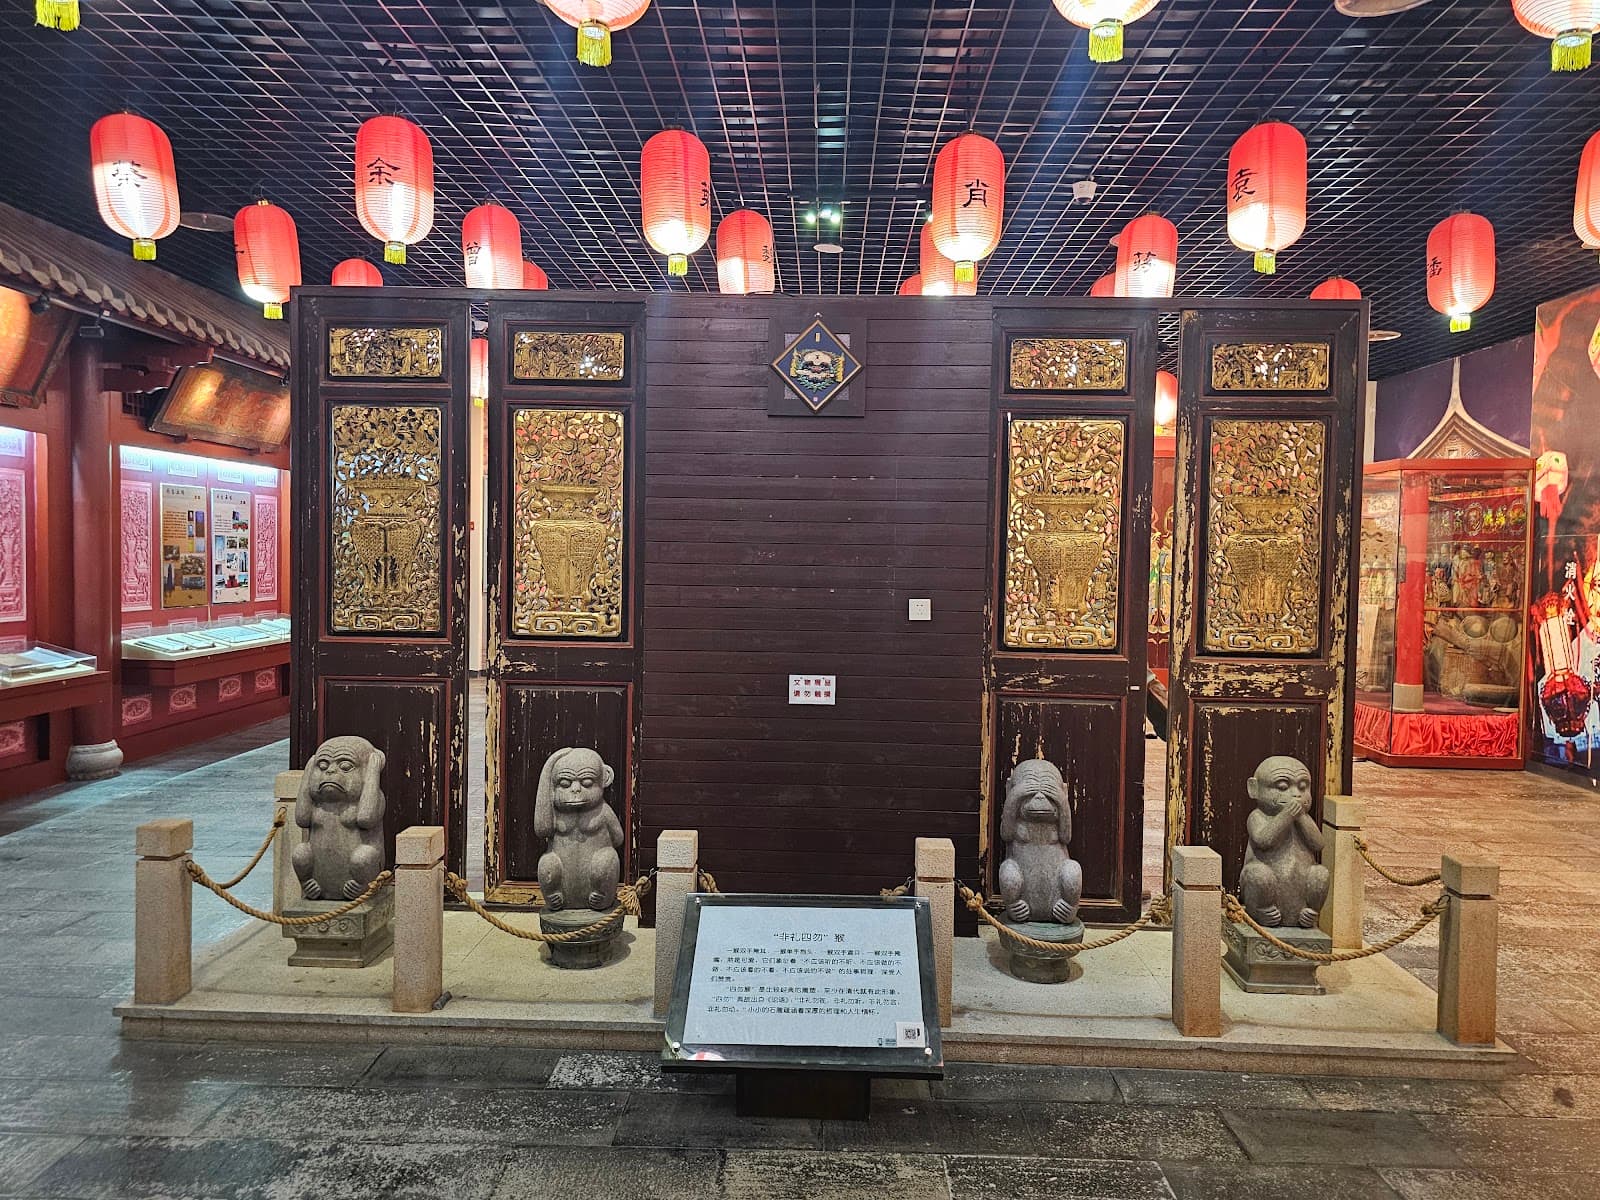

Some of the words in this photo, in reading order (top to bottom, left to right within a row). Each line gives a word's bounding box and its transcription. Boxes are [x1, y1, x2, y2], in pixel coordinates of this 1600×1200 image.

[367, 157, 401, 185] 余
[1231, 168, 1258, 203] 袁
[961, 178, 990, 208] 肖
[465, 241, 482, 266] 曾
[1563, 561, 1578, 626] 消火栓
